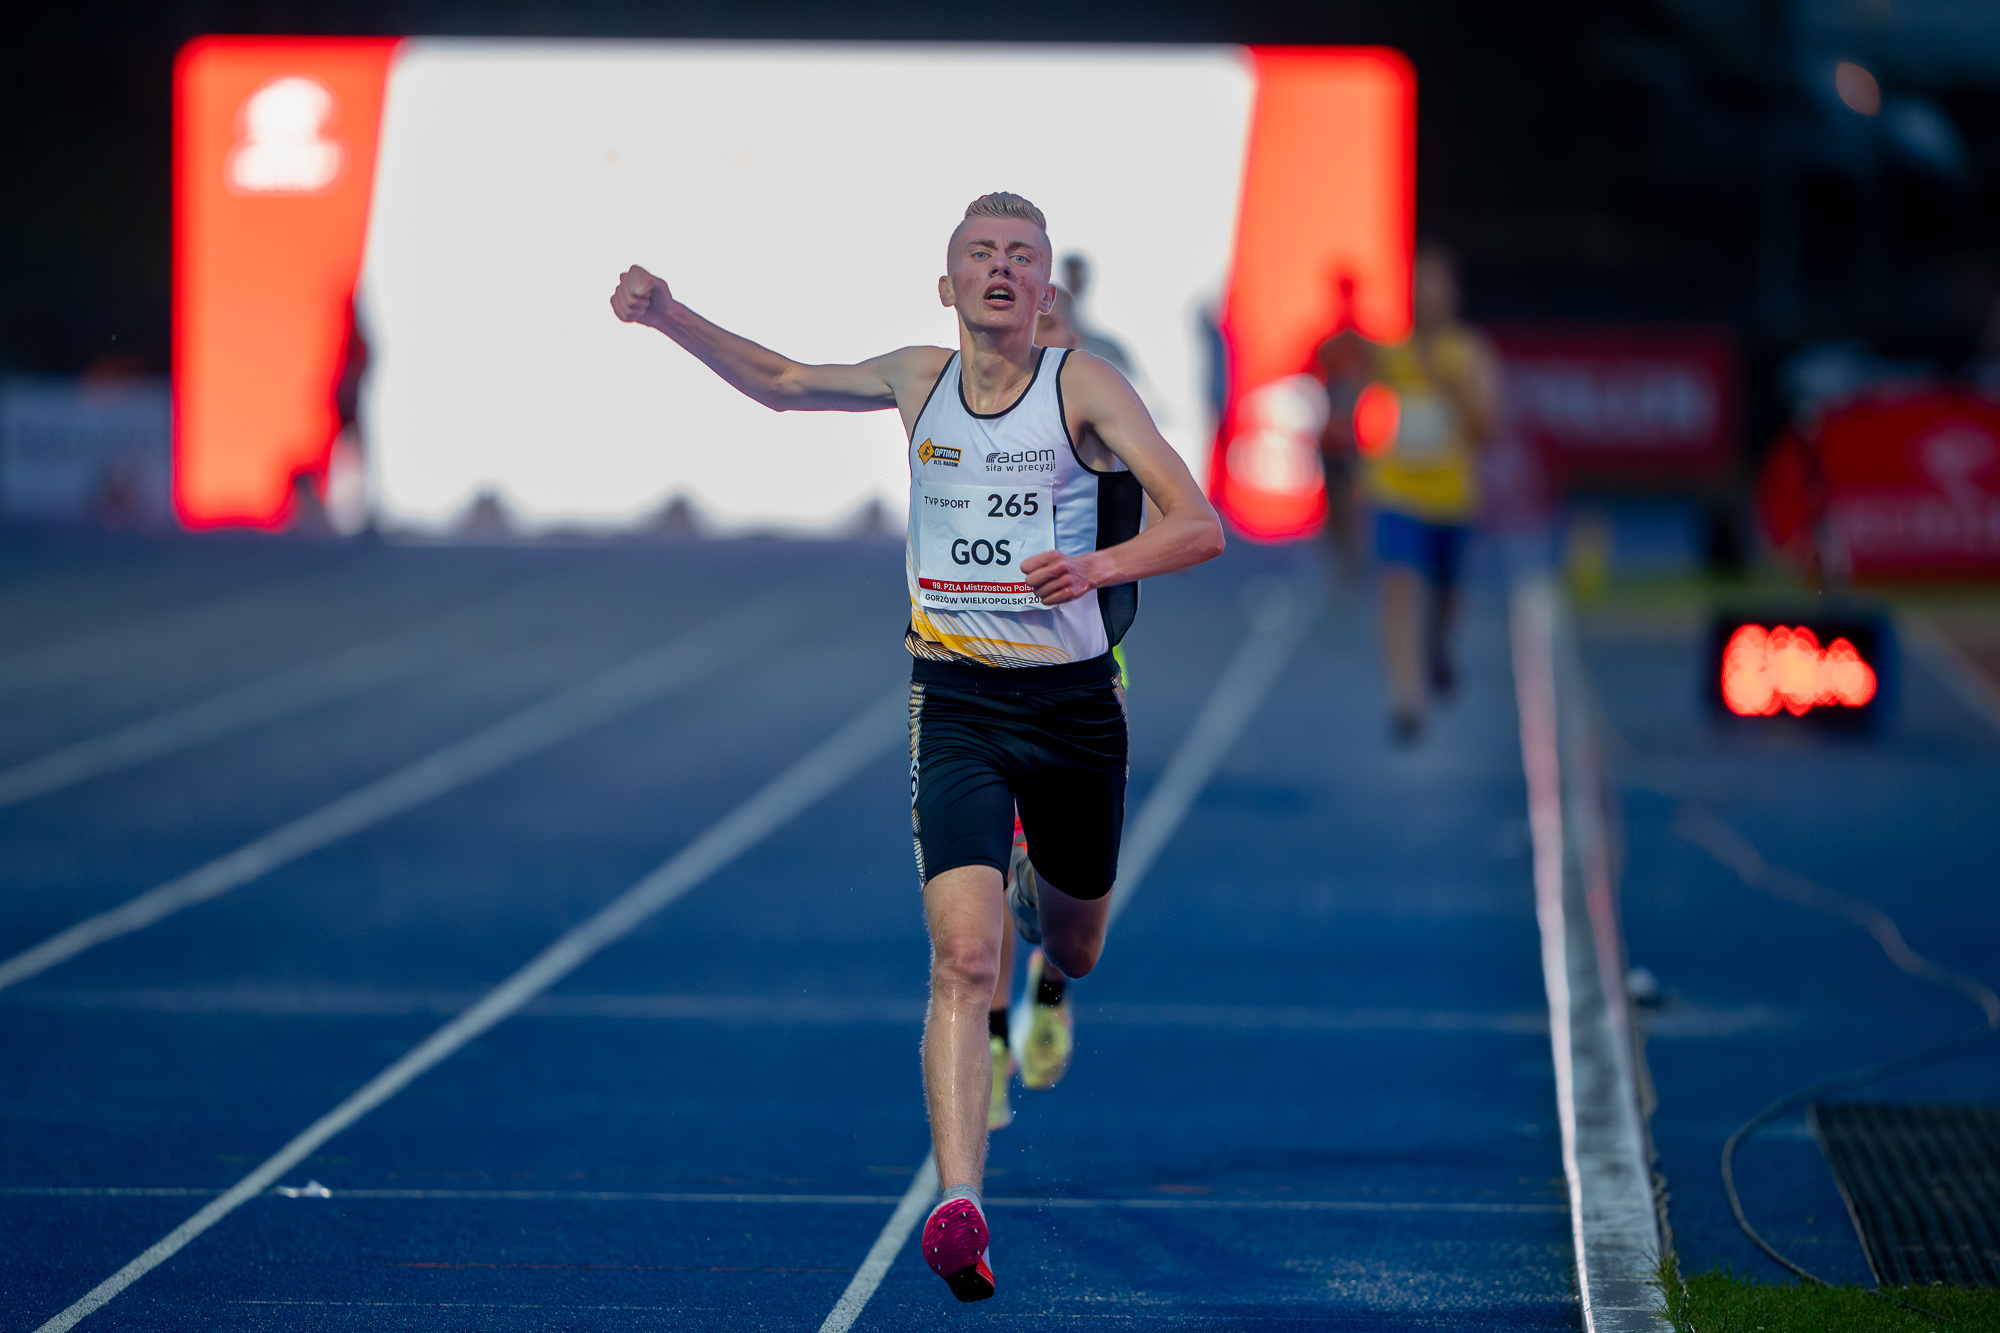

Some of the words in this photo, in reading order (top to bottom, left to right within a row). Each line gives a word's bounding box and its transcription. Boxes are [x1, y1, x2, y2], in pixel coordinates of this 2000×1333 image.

[934, 448, 959, 460] OPTIMA
[985, 464, 1002, 472] siła
[1018, 461, 1056, 473] precyzji
[924, 496, 939, 506] TVP
[940, 498, 970, 509] SPORT
[987, 492, 1039, 518] 265
[951, 538, 1012, 566] GOS
[932, 581, 943, 590] 99.
[943, 583, 962, 591] PZLA
[963, 583, 1012, 592] Mistrzostwa
[925, 593, 958, 604] GORZÓW
[960, 596, 1027, 605] WIELKOPOLSKI
[1028, 596, 1042, 604] 20
